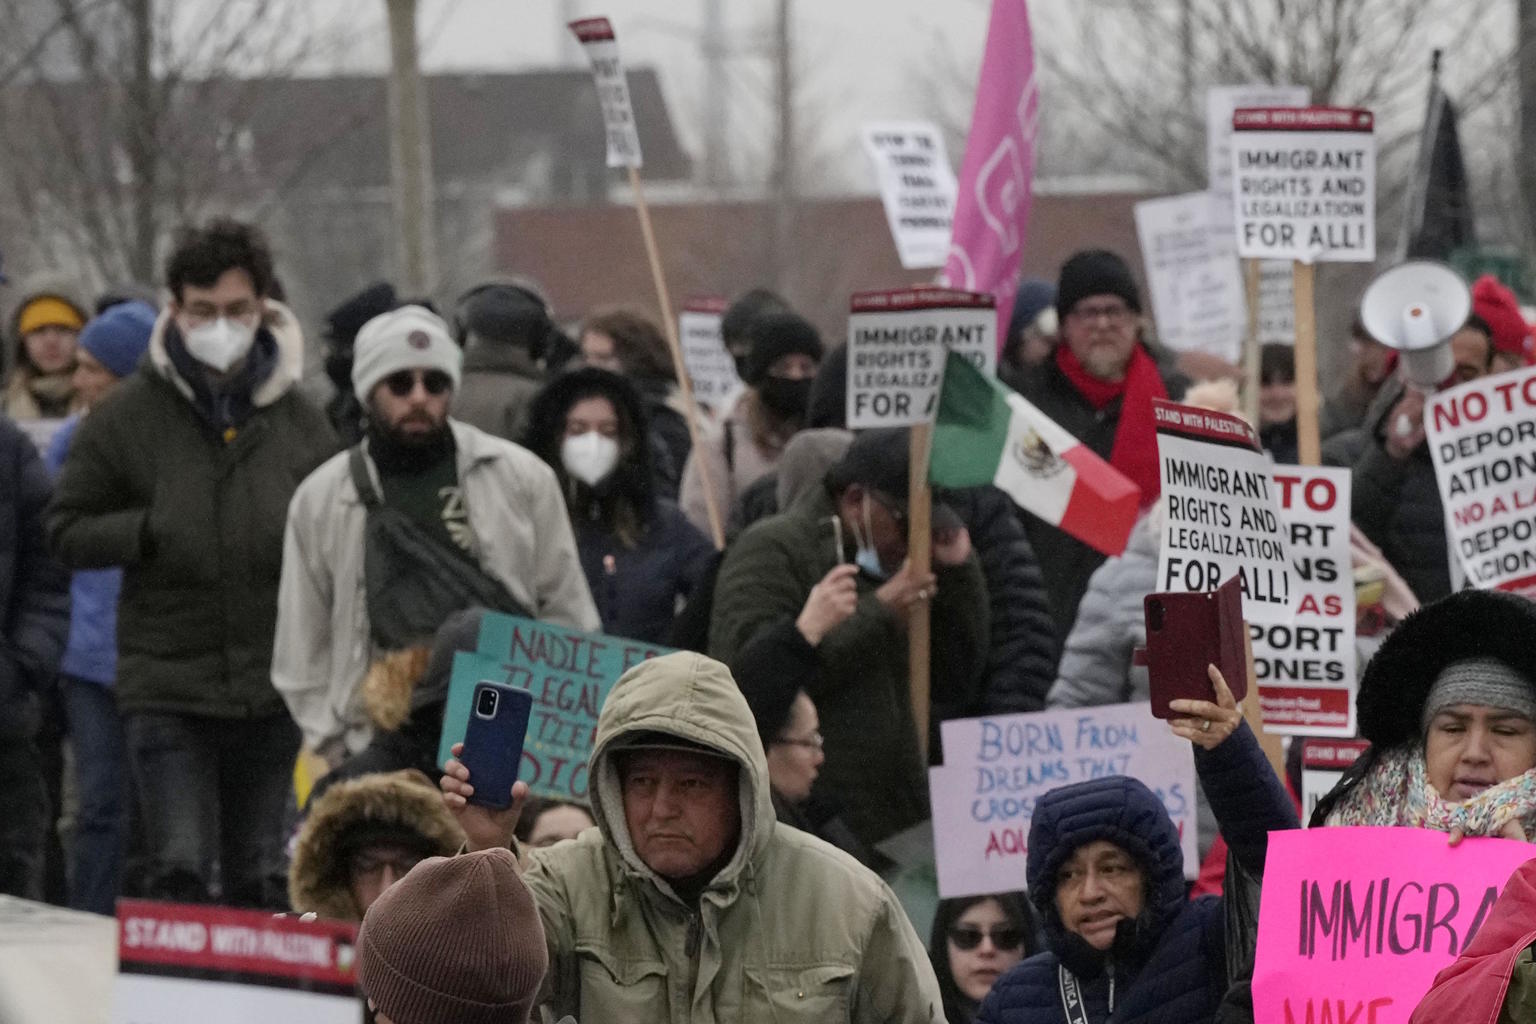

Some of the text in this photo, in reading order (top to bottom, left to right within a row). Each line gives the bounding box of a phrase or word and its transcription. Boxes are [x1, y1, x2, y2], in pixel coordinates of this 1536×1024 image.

[1239, 150, 1365, 169] IMMIGRANT
[1240, 178, 1365, 195] RIGHTS AND
[1242, 201, 1364, 217] LEGALIZATION
[1243, 223, 1365, 249] FOR ALL!
[855, 325, 986, 345] IMMIGRANT
[855, 352, 931, 368] RIGHTS
[855, 393, 911, 417] FOR
[1155, 407, 1181, 425] STAND
[1183, 414, 1203, 428] WITH
[1433, 391, 1488, 432] NO
[1165, 458, 1269, 501] IMMIGRANT
[1272, 475, 1337, 512] TO
[1169, 495, 1277, 534] RIGHTS AND
[1454, 503, 1484, 527] NO
[1490, 496, 1509, 517] A
[1169, 528, 1285, 562] LEGALIZATION
[1165, 558, 1221, 593] FOR
[510, 625, 658, 678] NADIE E
[534, 710, 598, 751] TIE
[977, 716, 1139, 762] BORN FROM
[972, 796, 1040, 823] CROS
[124, 917, 333, 967] STAND WITH PALESTINE
